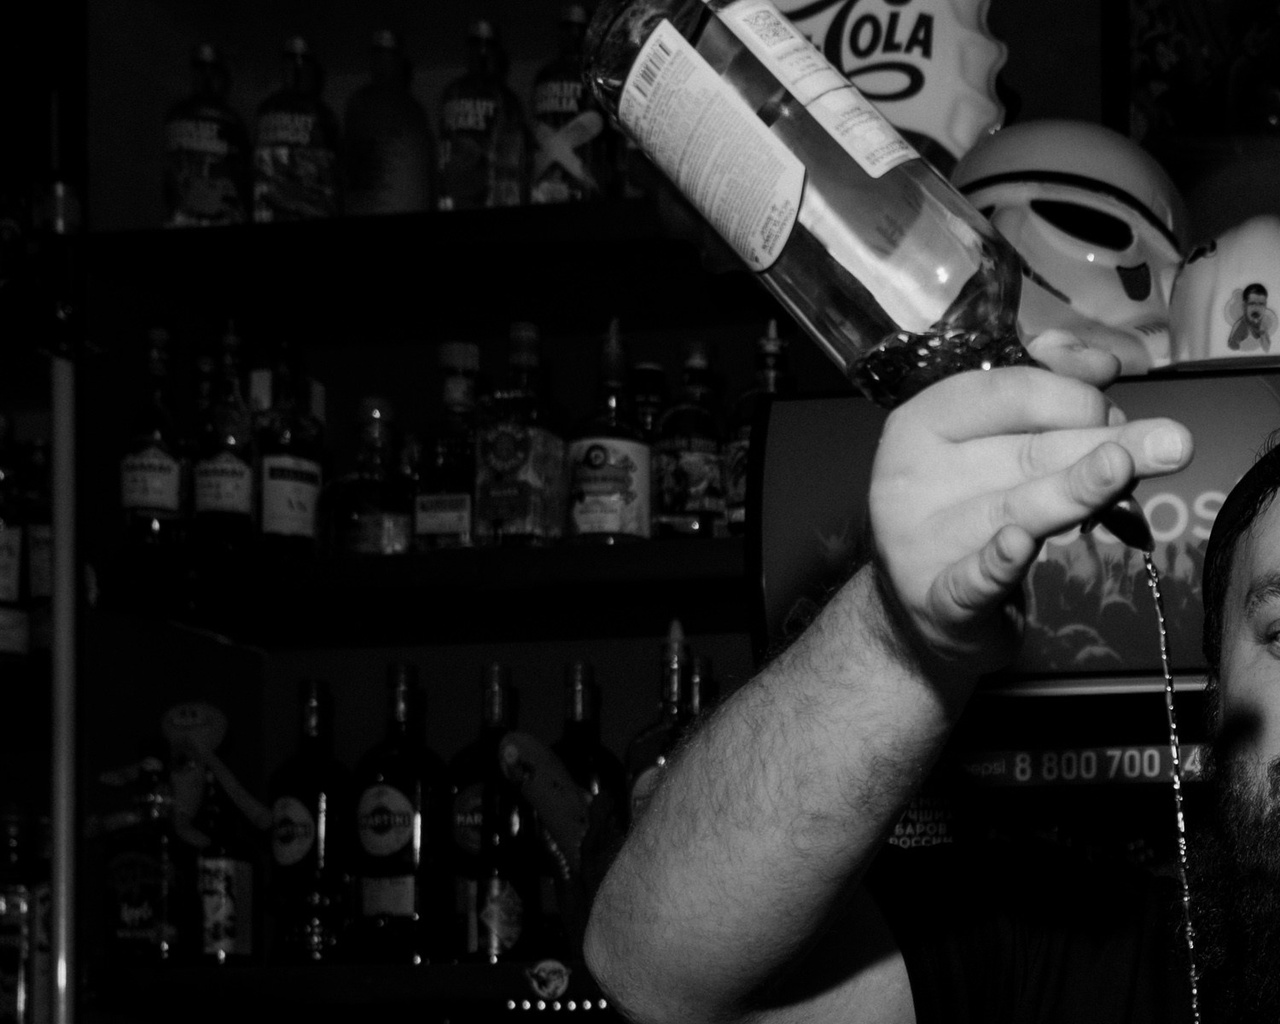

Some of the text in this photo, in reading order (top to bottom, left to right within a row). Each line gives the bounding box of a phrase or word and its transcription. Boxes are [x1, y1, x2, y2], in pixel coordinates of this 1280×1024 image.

[1013, 752, 1033, 782] 8
[1041, 750, 1098, 781] 800
[1106, 748, 1162, 779] 700
